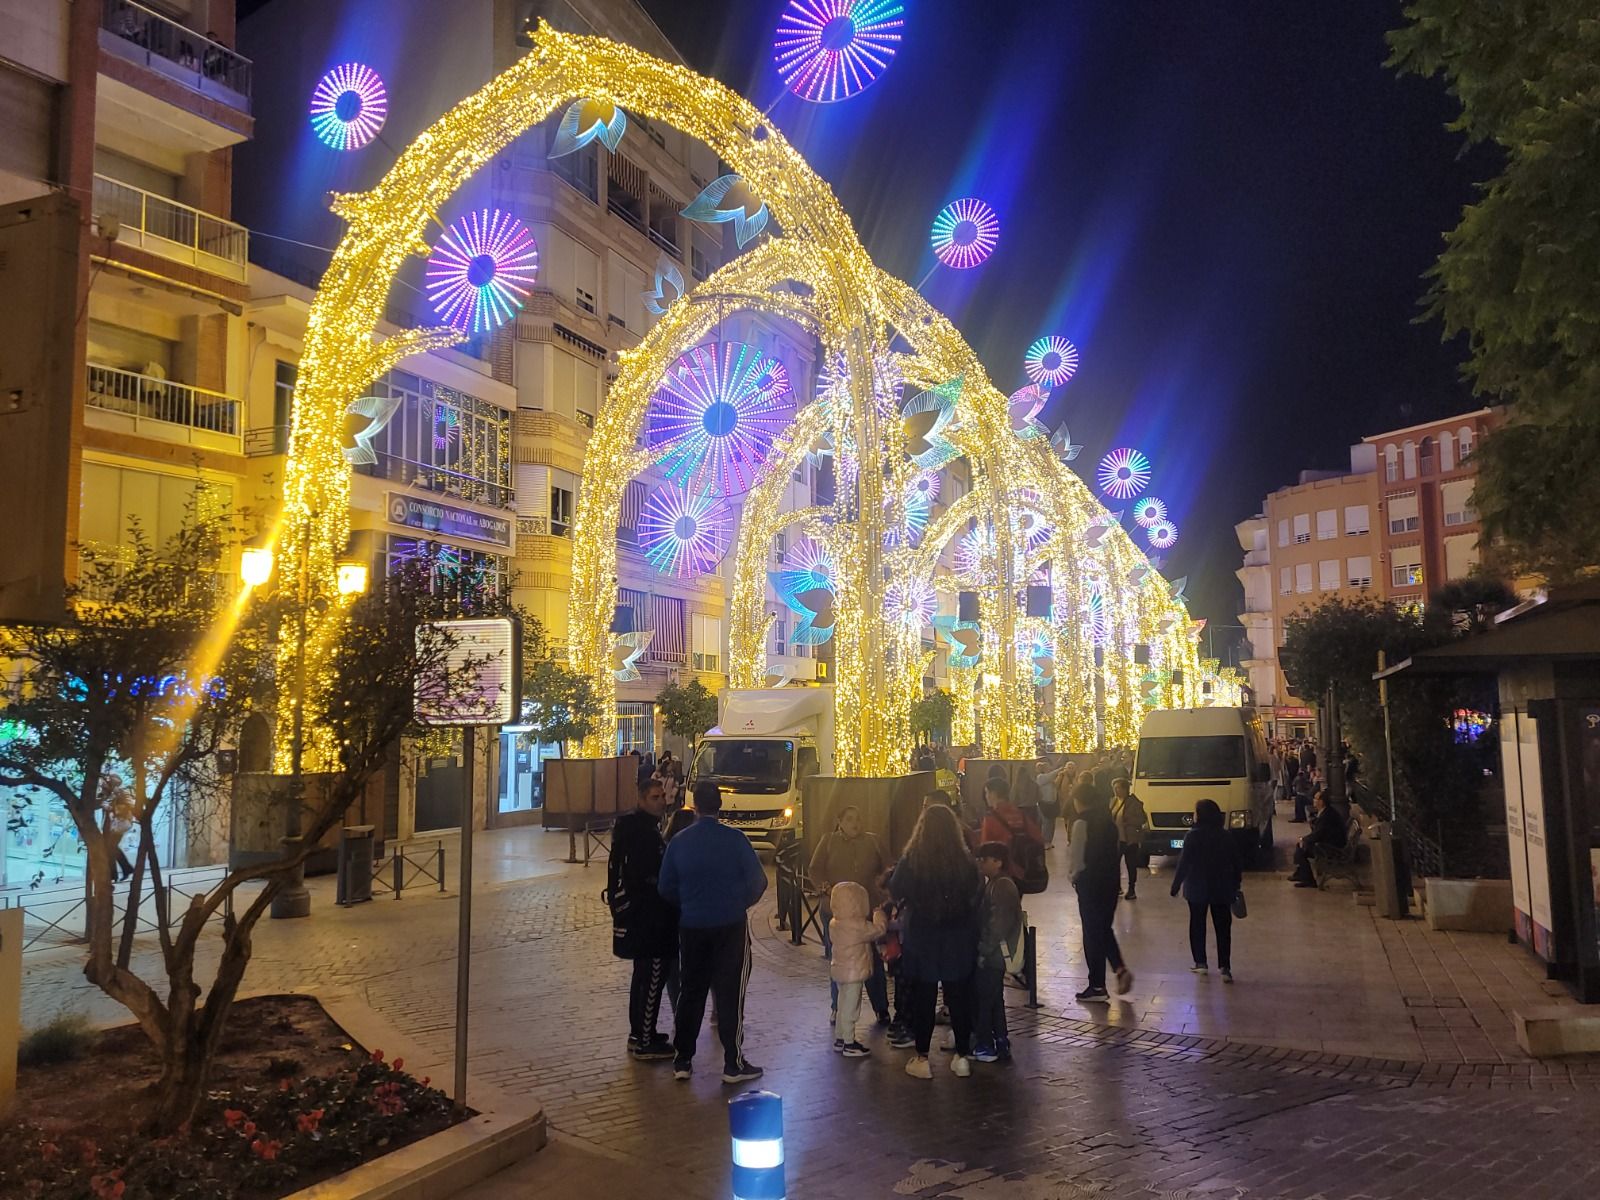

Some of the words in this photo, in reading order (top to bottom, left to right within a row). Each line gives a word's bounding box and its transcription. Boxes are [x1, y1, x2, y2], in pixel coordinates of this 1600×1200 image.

[409, 502, 444, 519] CONSORCIO
[445, 510, 473, 525] NACIONAL
[479, 518, 506, 533] ABOGADOS
